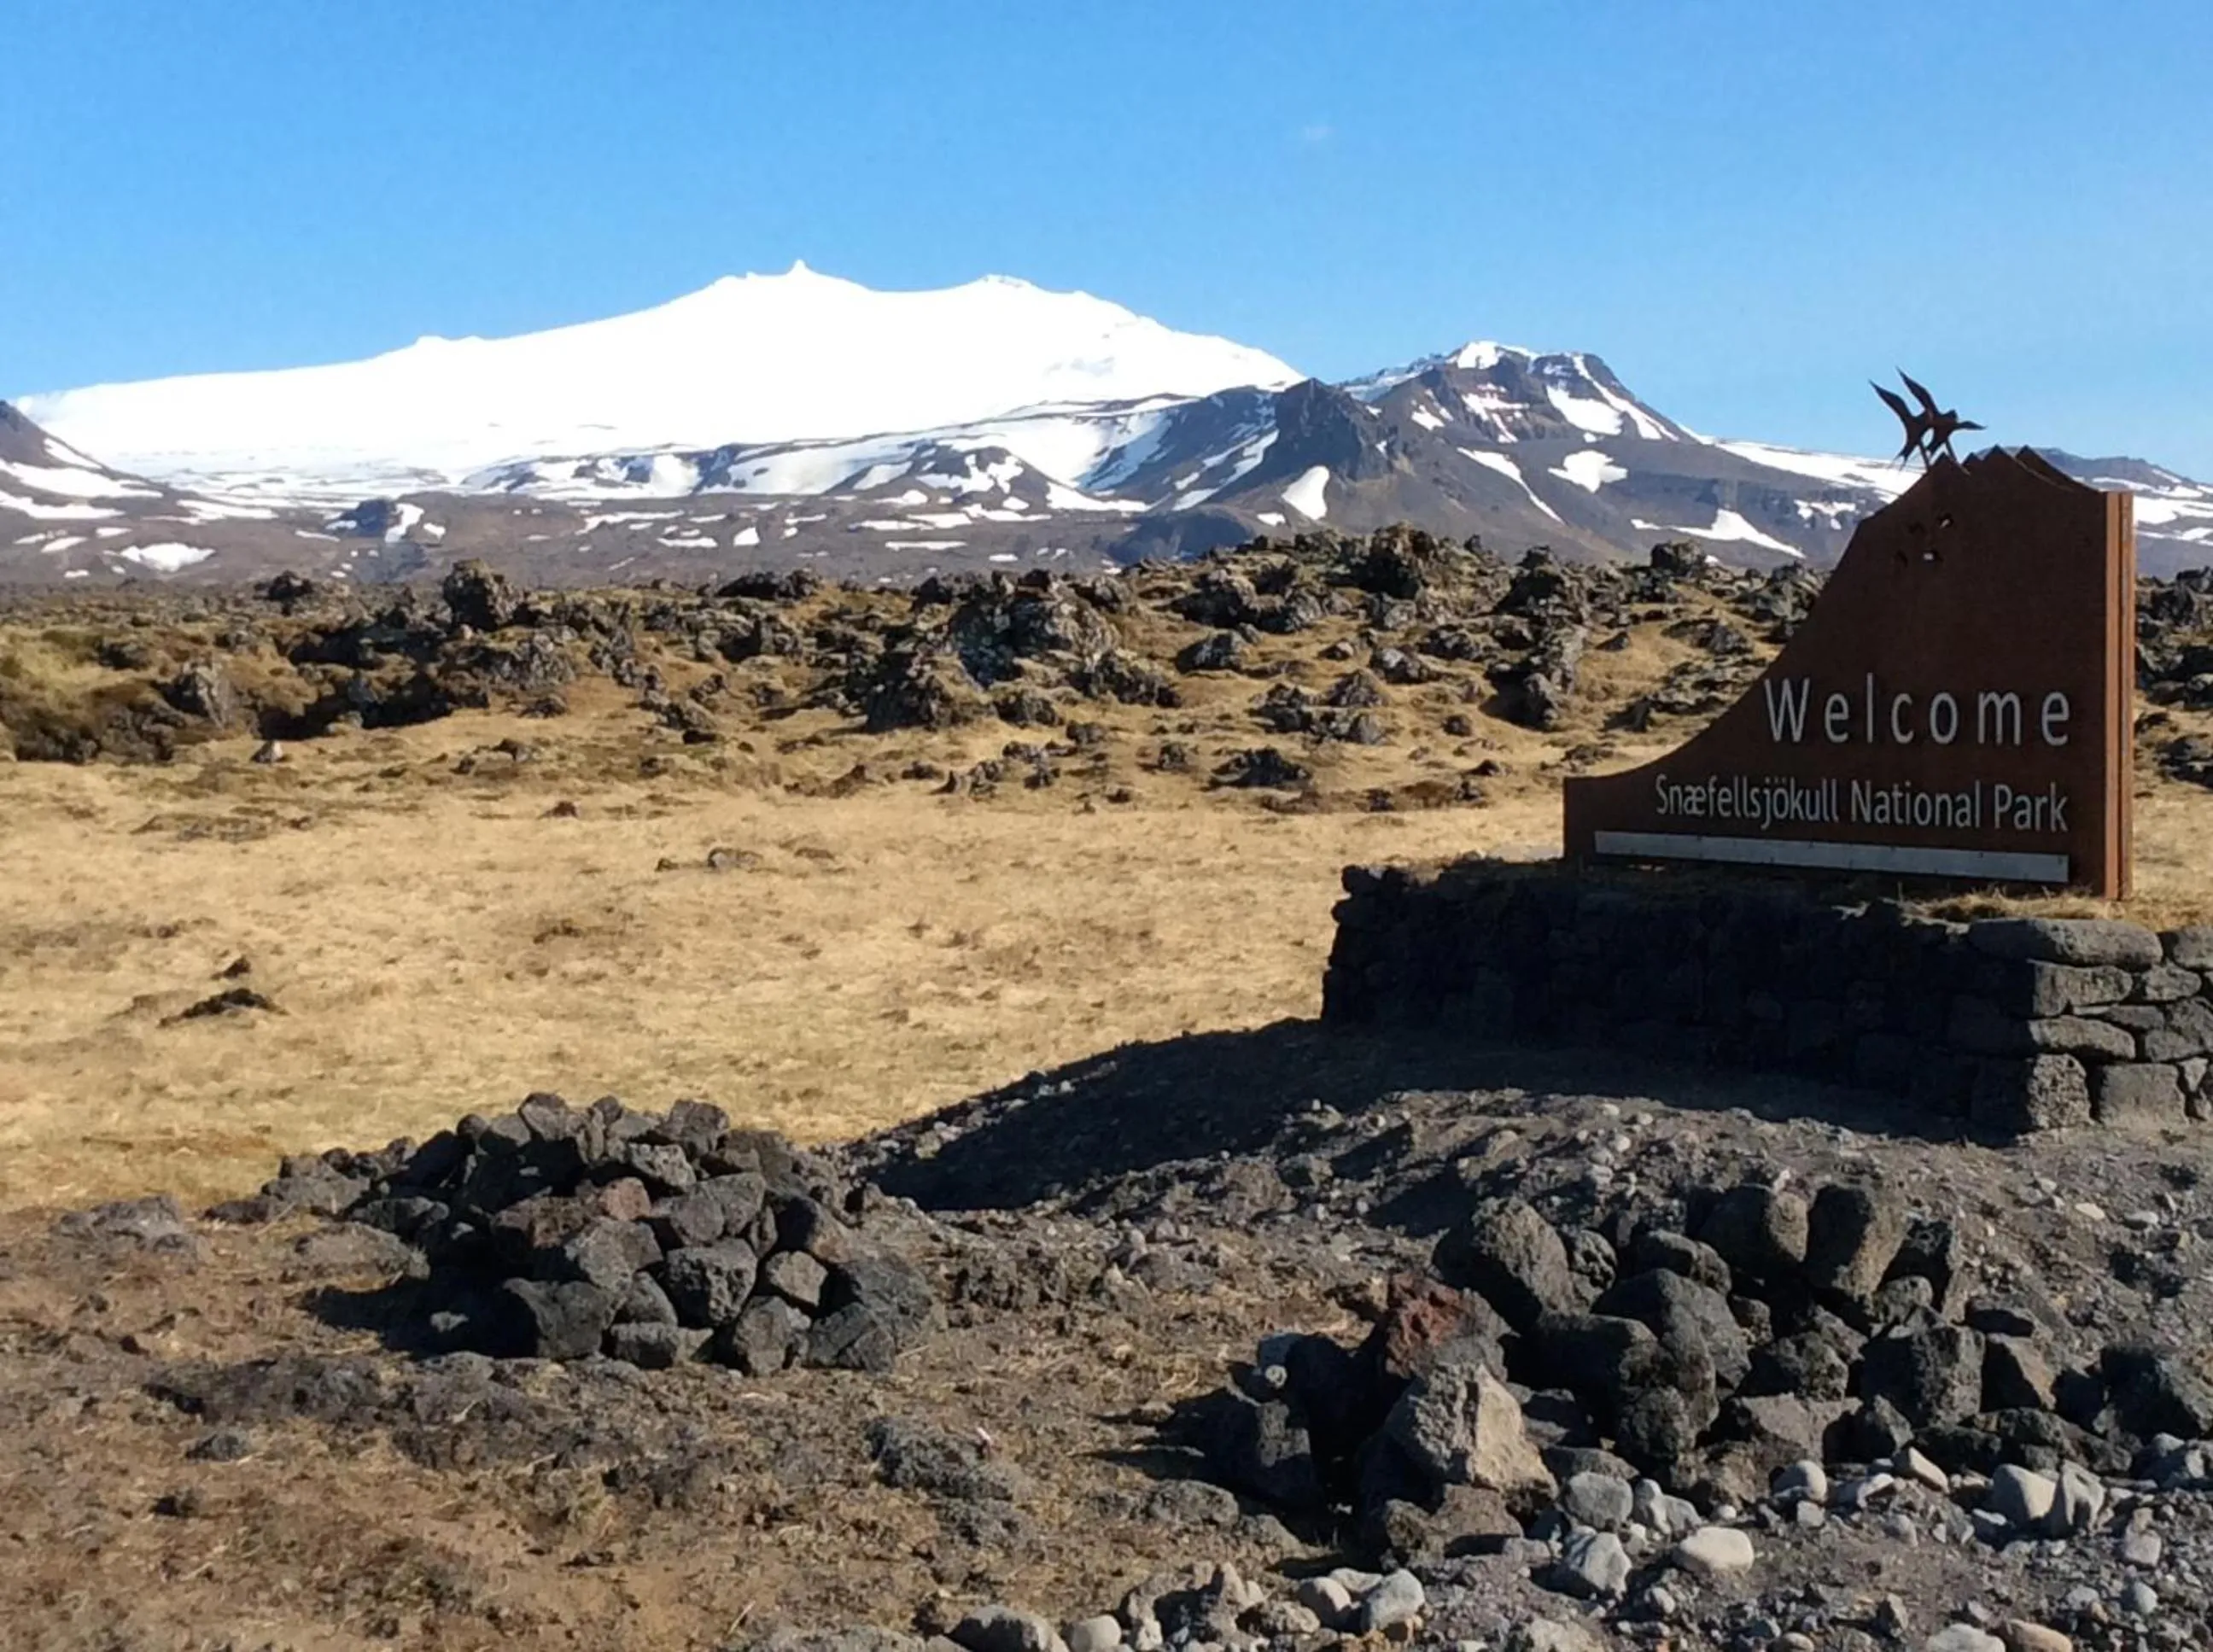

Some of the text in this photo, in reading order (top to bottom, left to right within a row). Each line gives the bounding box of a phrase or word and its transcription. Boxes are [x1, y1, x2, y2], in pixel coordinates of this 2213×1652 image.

[1763, 673, 2070, 746] Welcome
[1655, 773, 2068, 832] Snæfellsjökull National Park
